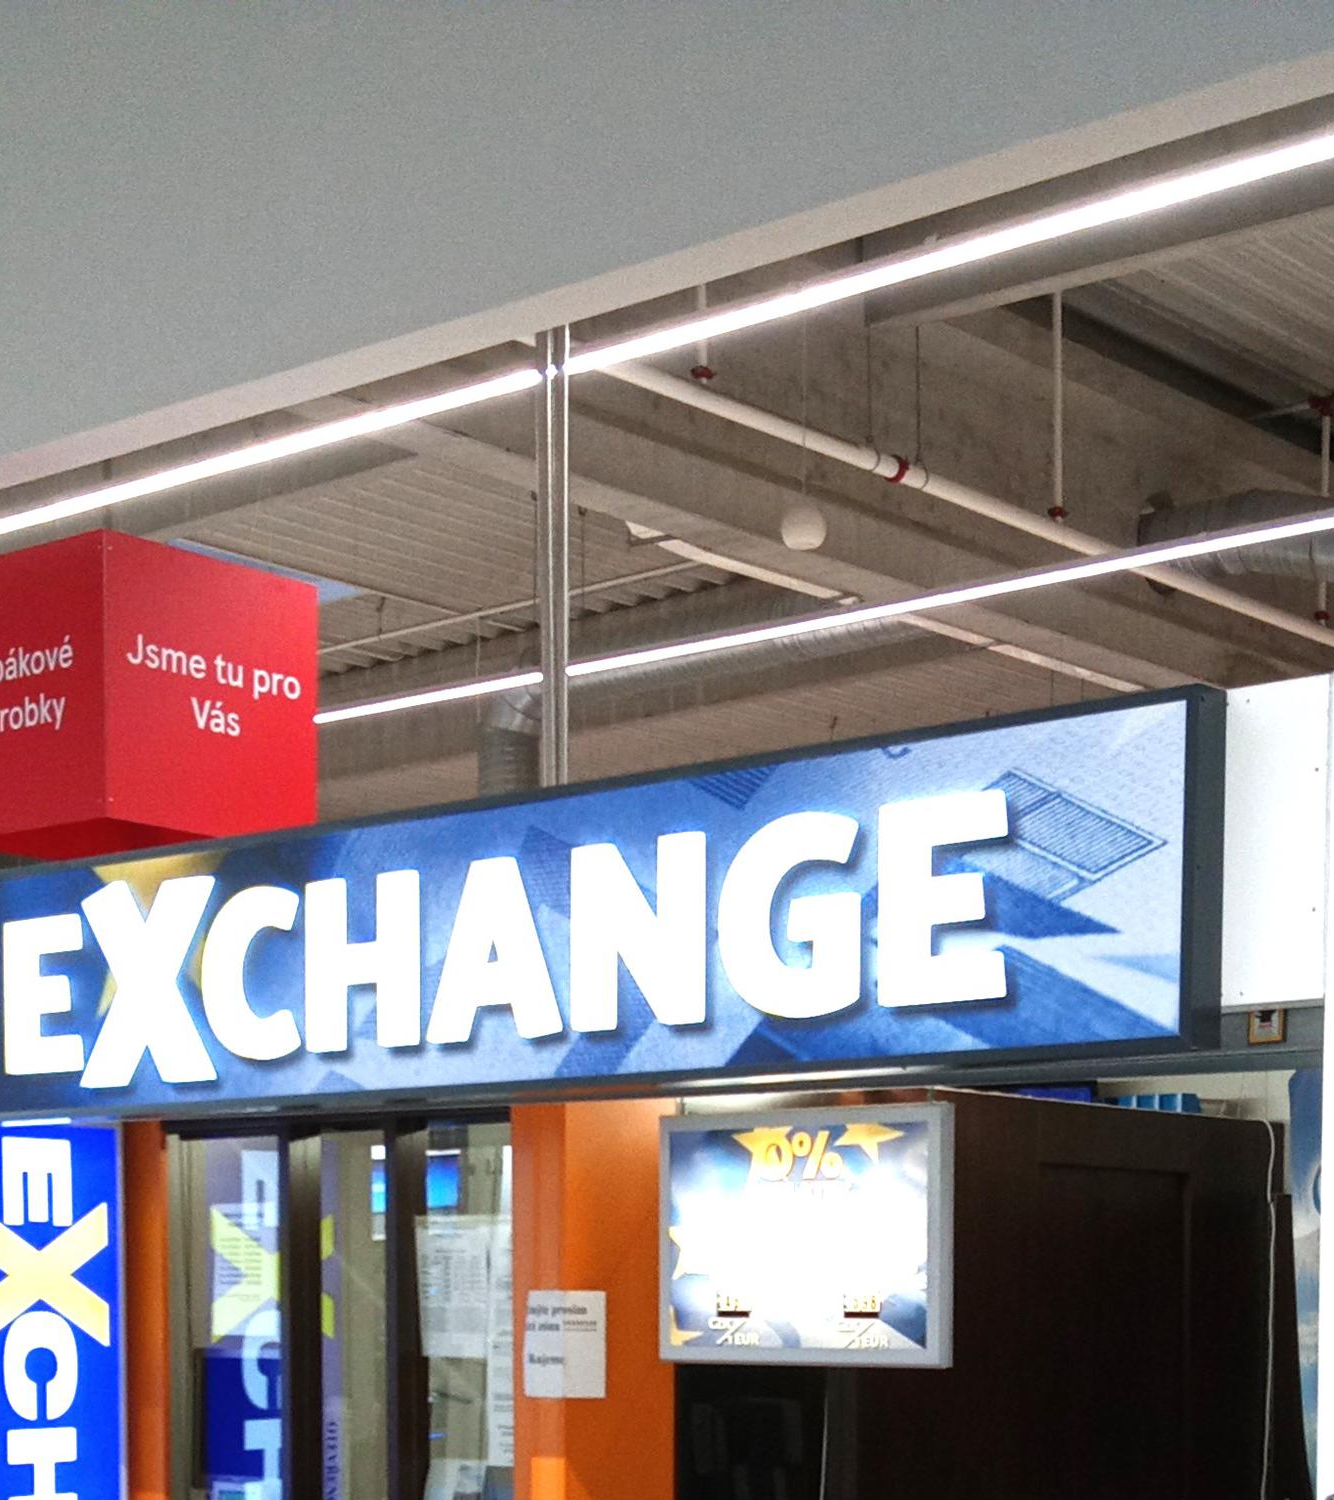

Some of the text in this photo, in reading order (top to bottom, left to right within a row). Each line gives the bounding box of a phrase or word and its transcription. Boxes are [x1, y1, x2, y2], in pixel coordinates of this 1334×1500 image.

[126, 633, 302, 701] Jsme tu pro
[190, 696, 242, 737] Vás
[2, 788, 1010, 1090] EXCHANGE
